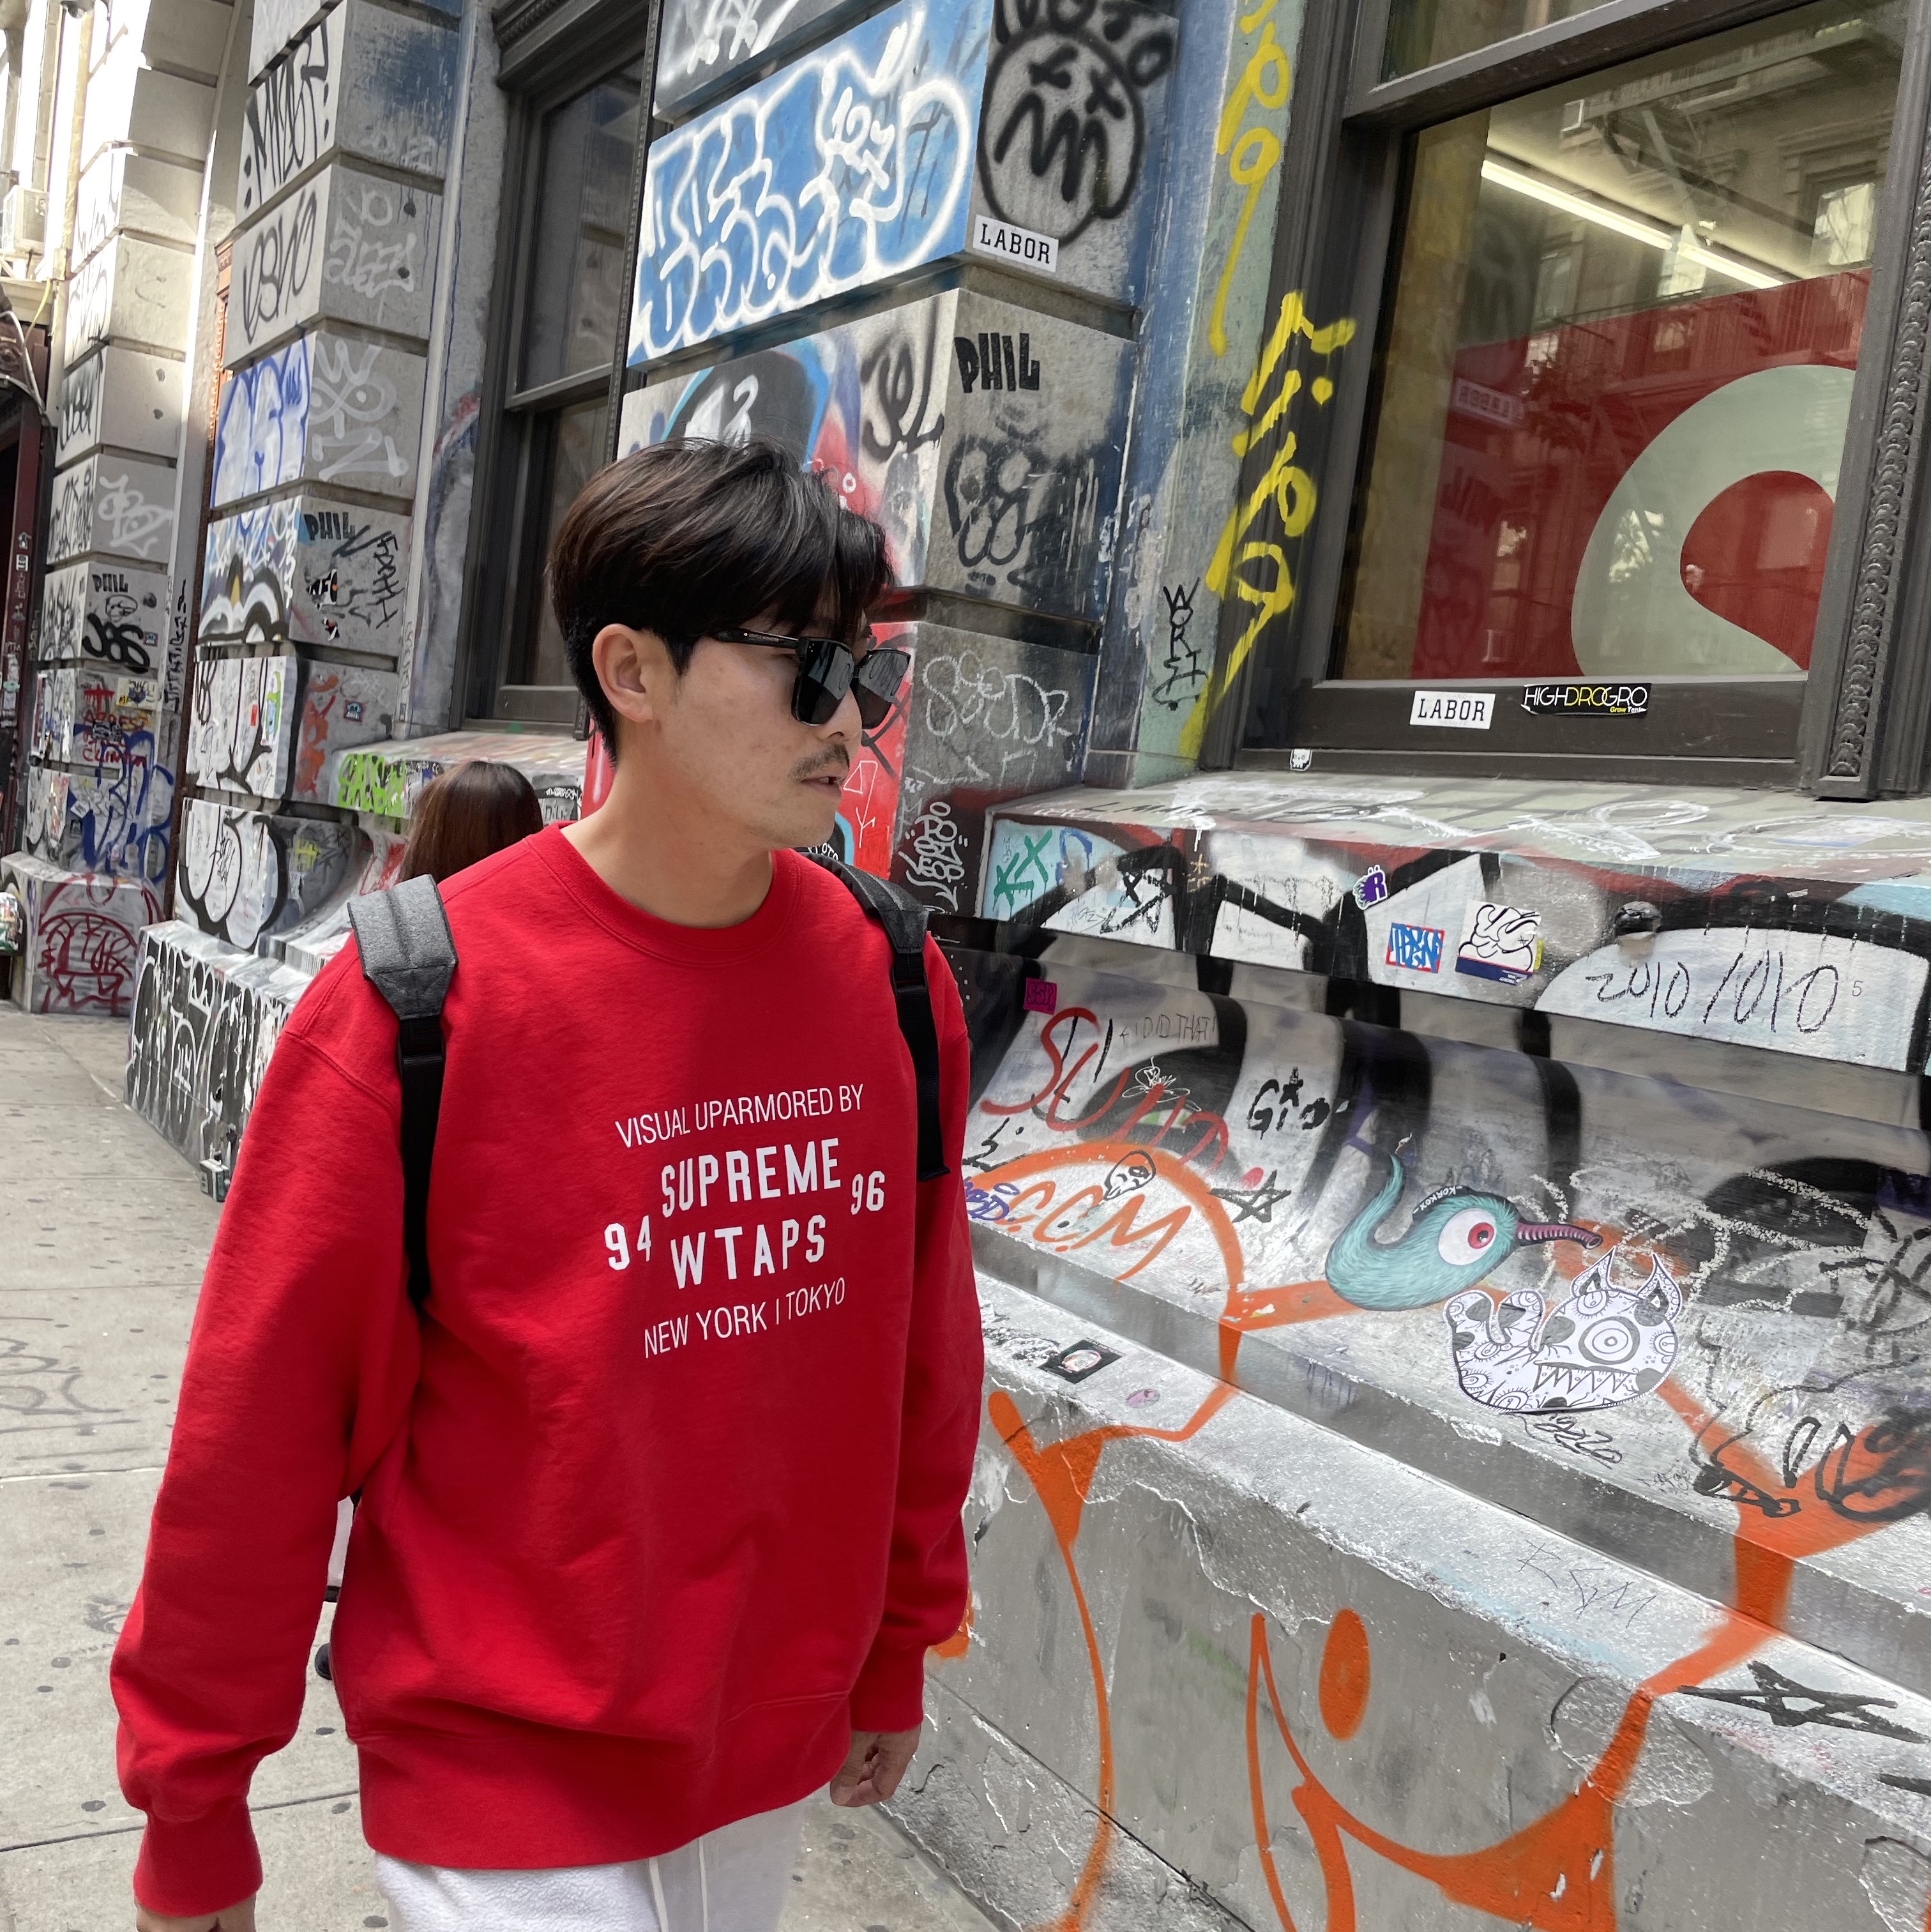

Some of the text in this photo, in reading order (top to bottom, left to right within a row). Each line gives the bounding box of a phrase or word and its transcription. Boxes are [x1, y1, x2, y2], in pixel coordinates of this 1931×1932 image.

[980, 224, 1050, 265] LABOR
[955, 332, 1040, 393] PHIL
[304, 512, 356, 540] PHIL
[93, 573, 128, 593] PHIL
[1418, 698, 1485, 722] LABOR
[615, 1083, 864, 1148] VISUAL UPARMORED BY
[661, 1137, 842, 1218] SUPREME
[851, 1171, 885, 1215] 96
[604, 1215, 652, 1271] 94
[670, 1214, 826, 1290] WTAPS
[644, 1314, 689, 1359] NEW
[695, 1301, 767, 1341] YORK
[785, 1277, 846, 1320] TOKYO
